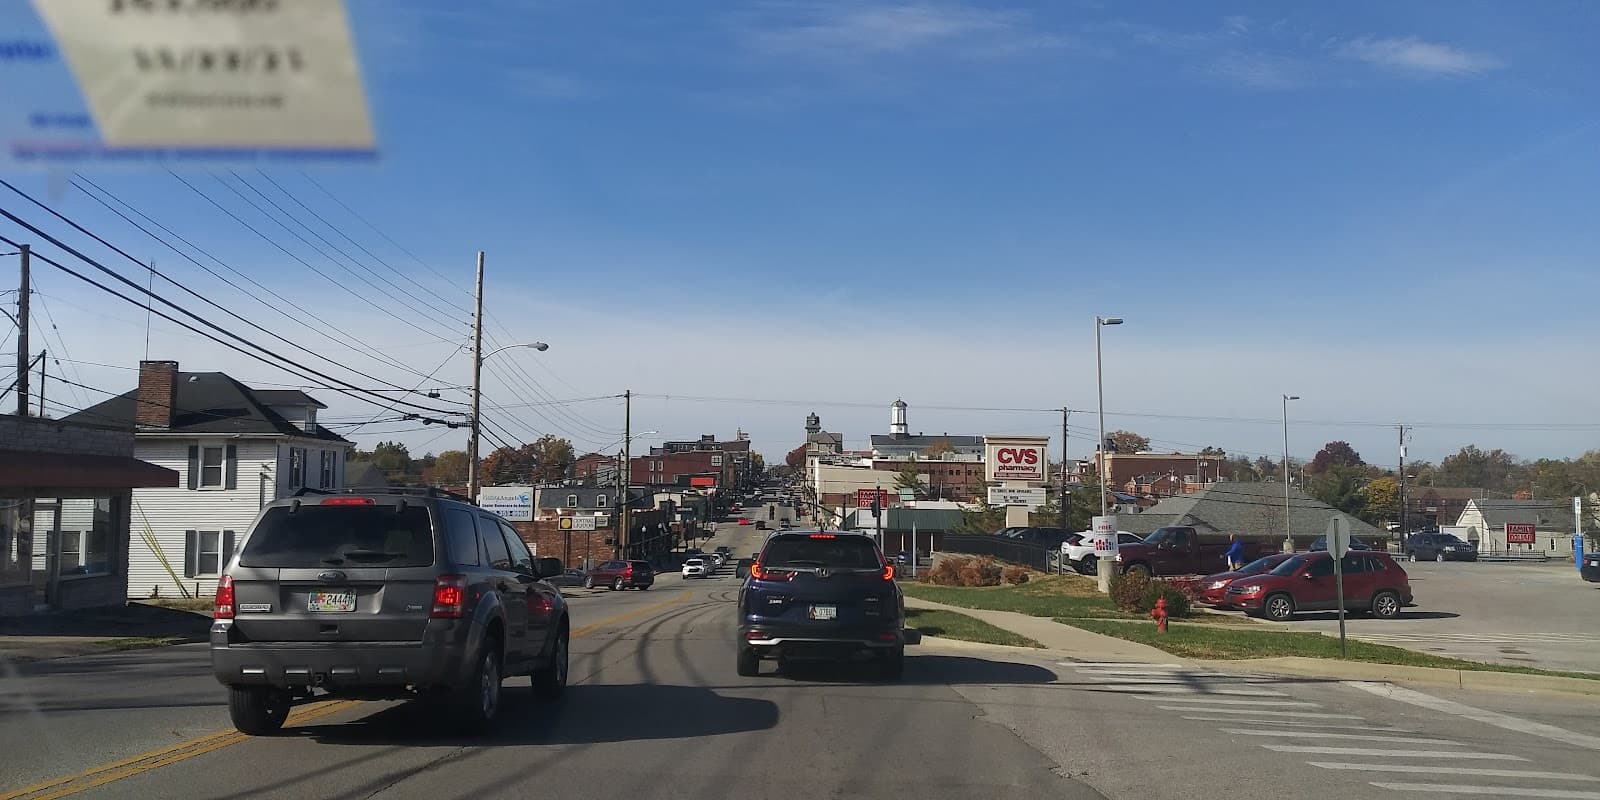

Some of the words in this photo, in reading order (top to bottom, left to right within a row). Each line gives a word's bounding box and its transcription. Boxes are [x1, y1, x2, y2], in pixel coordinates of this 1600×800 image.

[997, 447, 1038, 464] CVS
[998, 464, 1037, 472] pharmacy
[1508, 524, 1533, 533] FAMILY
[1509, 533, 1533, 542] DOLLAR
